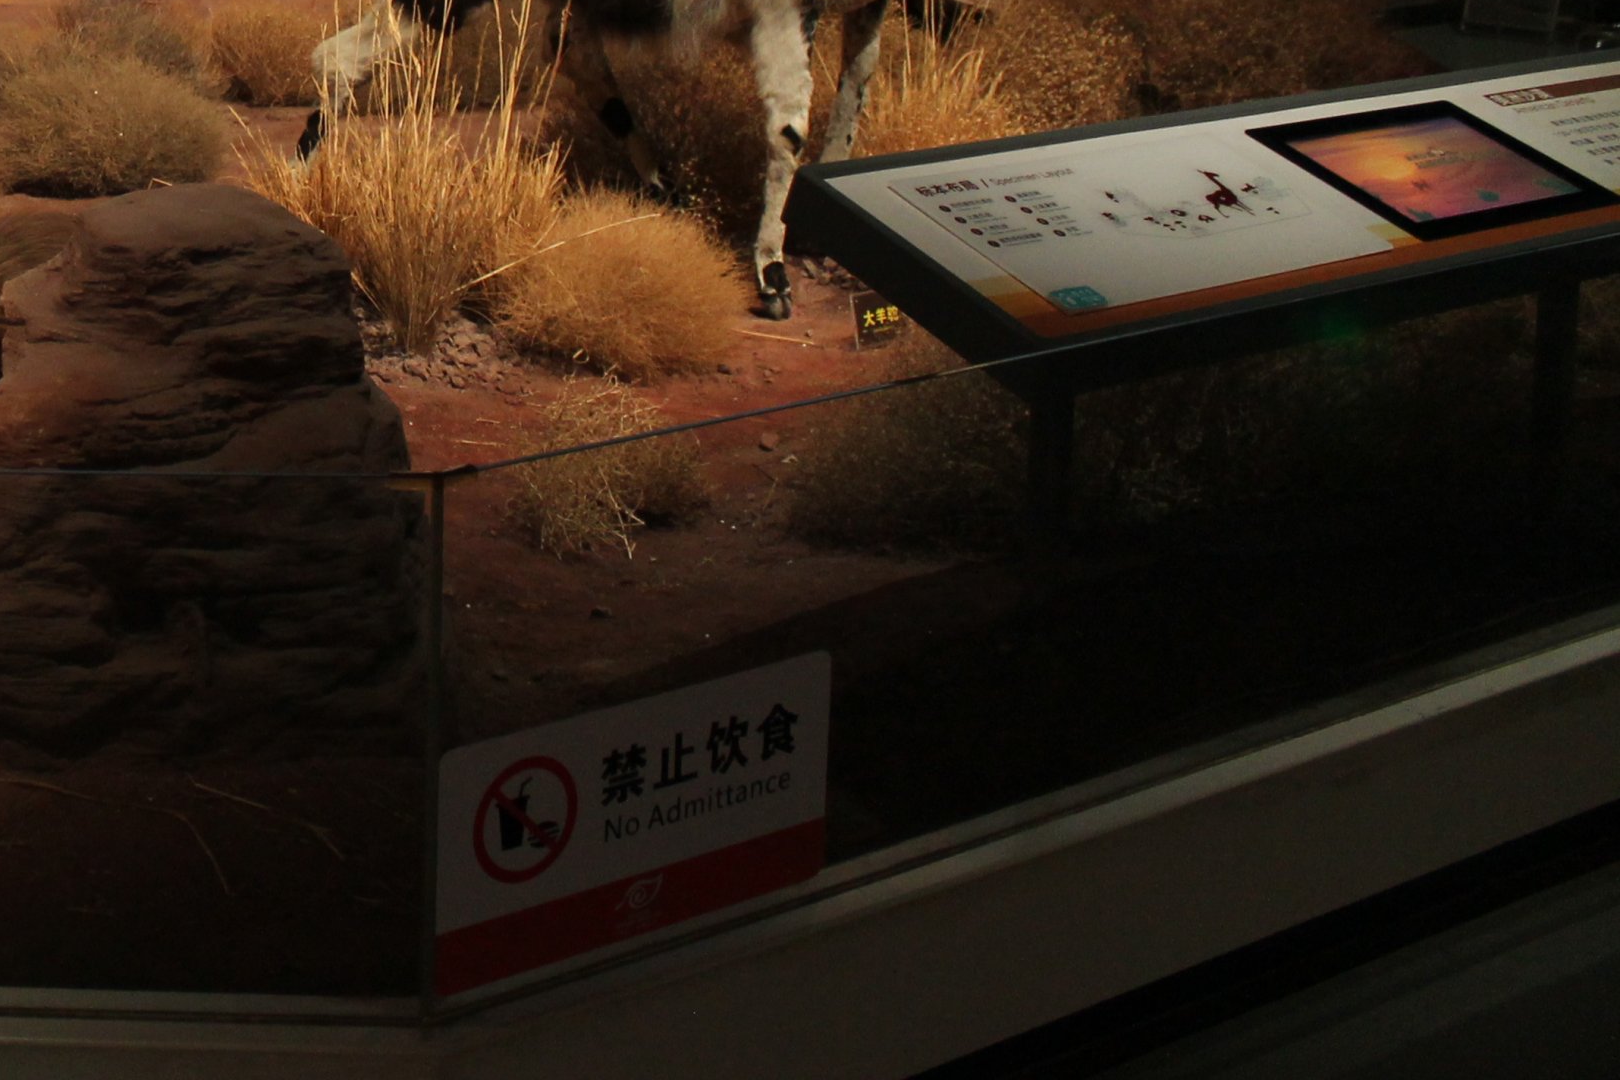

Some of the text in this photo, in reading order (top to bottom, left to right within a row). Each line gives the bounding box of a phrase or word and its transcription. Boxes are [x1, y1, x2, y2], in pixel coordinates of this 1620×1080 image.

[601, 702, 799, 806] 禁止饮食
[603, 771, 791, 842] No Admittance
